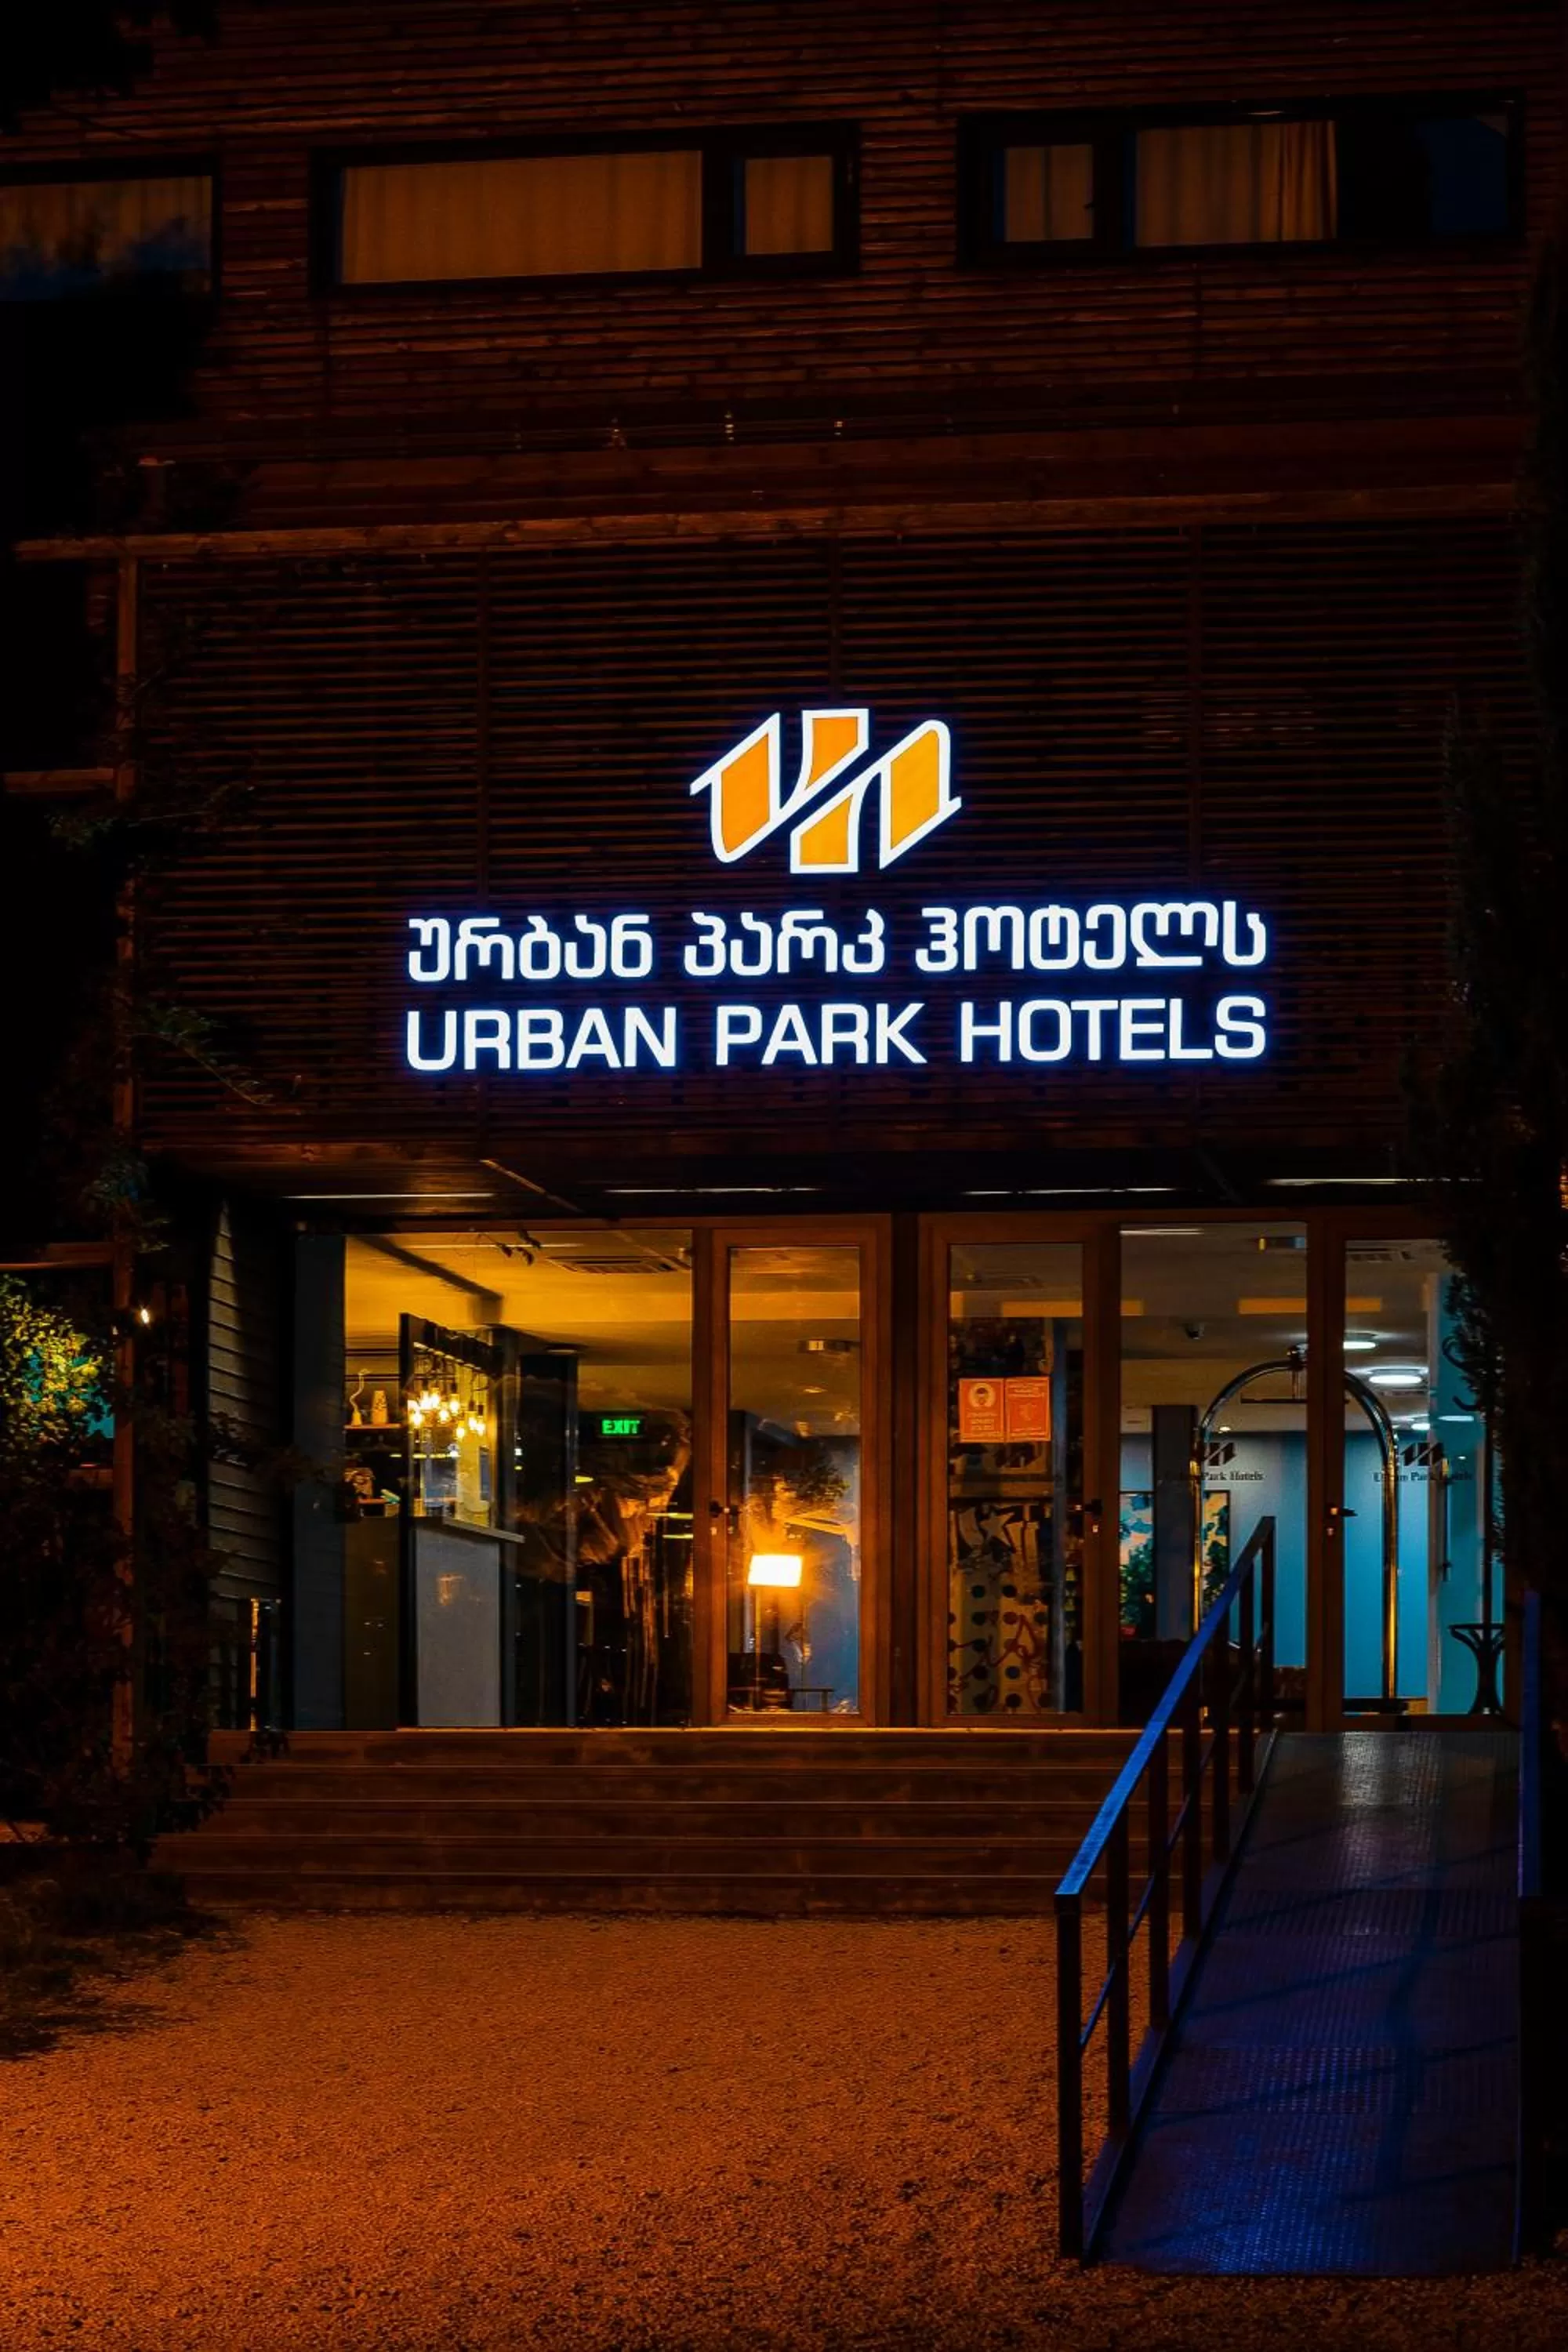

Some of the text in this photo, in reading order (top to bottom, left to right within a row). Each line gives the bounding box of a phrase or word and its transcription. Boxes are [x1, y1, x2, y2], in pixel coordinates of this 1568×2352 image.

[408, 900, 1267, 983] ურბან პარკ ჰოტელს
[407, 996, 1267, 1072] URBAN PARK HOTELS
[601, 1419, 641, 1435] EXIT
[1202, 1471, 1227, 1481] Park
[1229, 1471, 1265, 1481] Hotels
